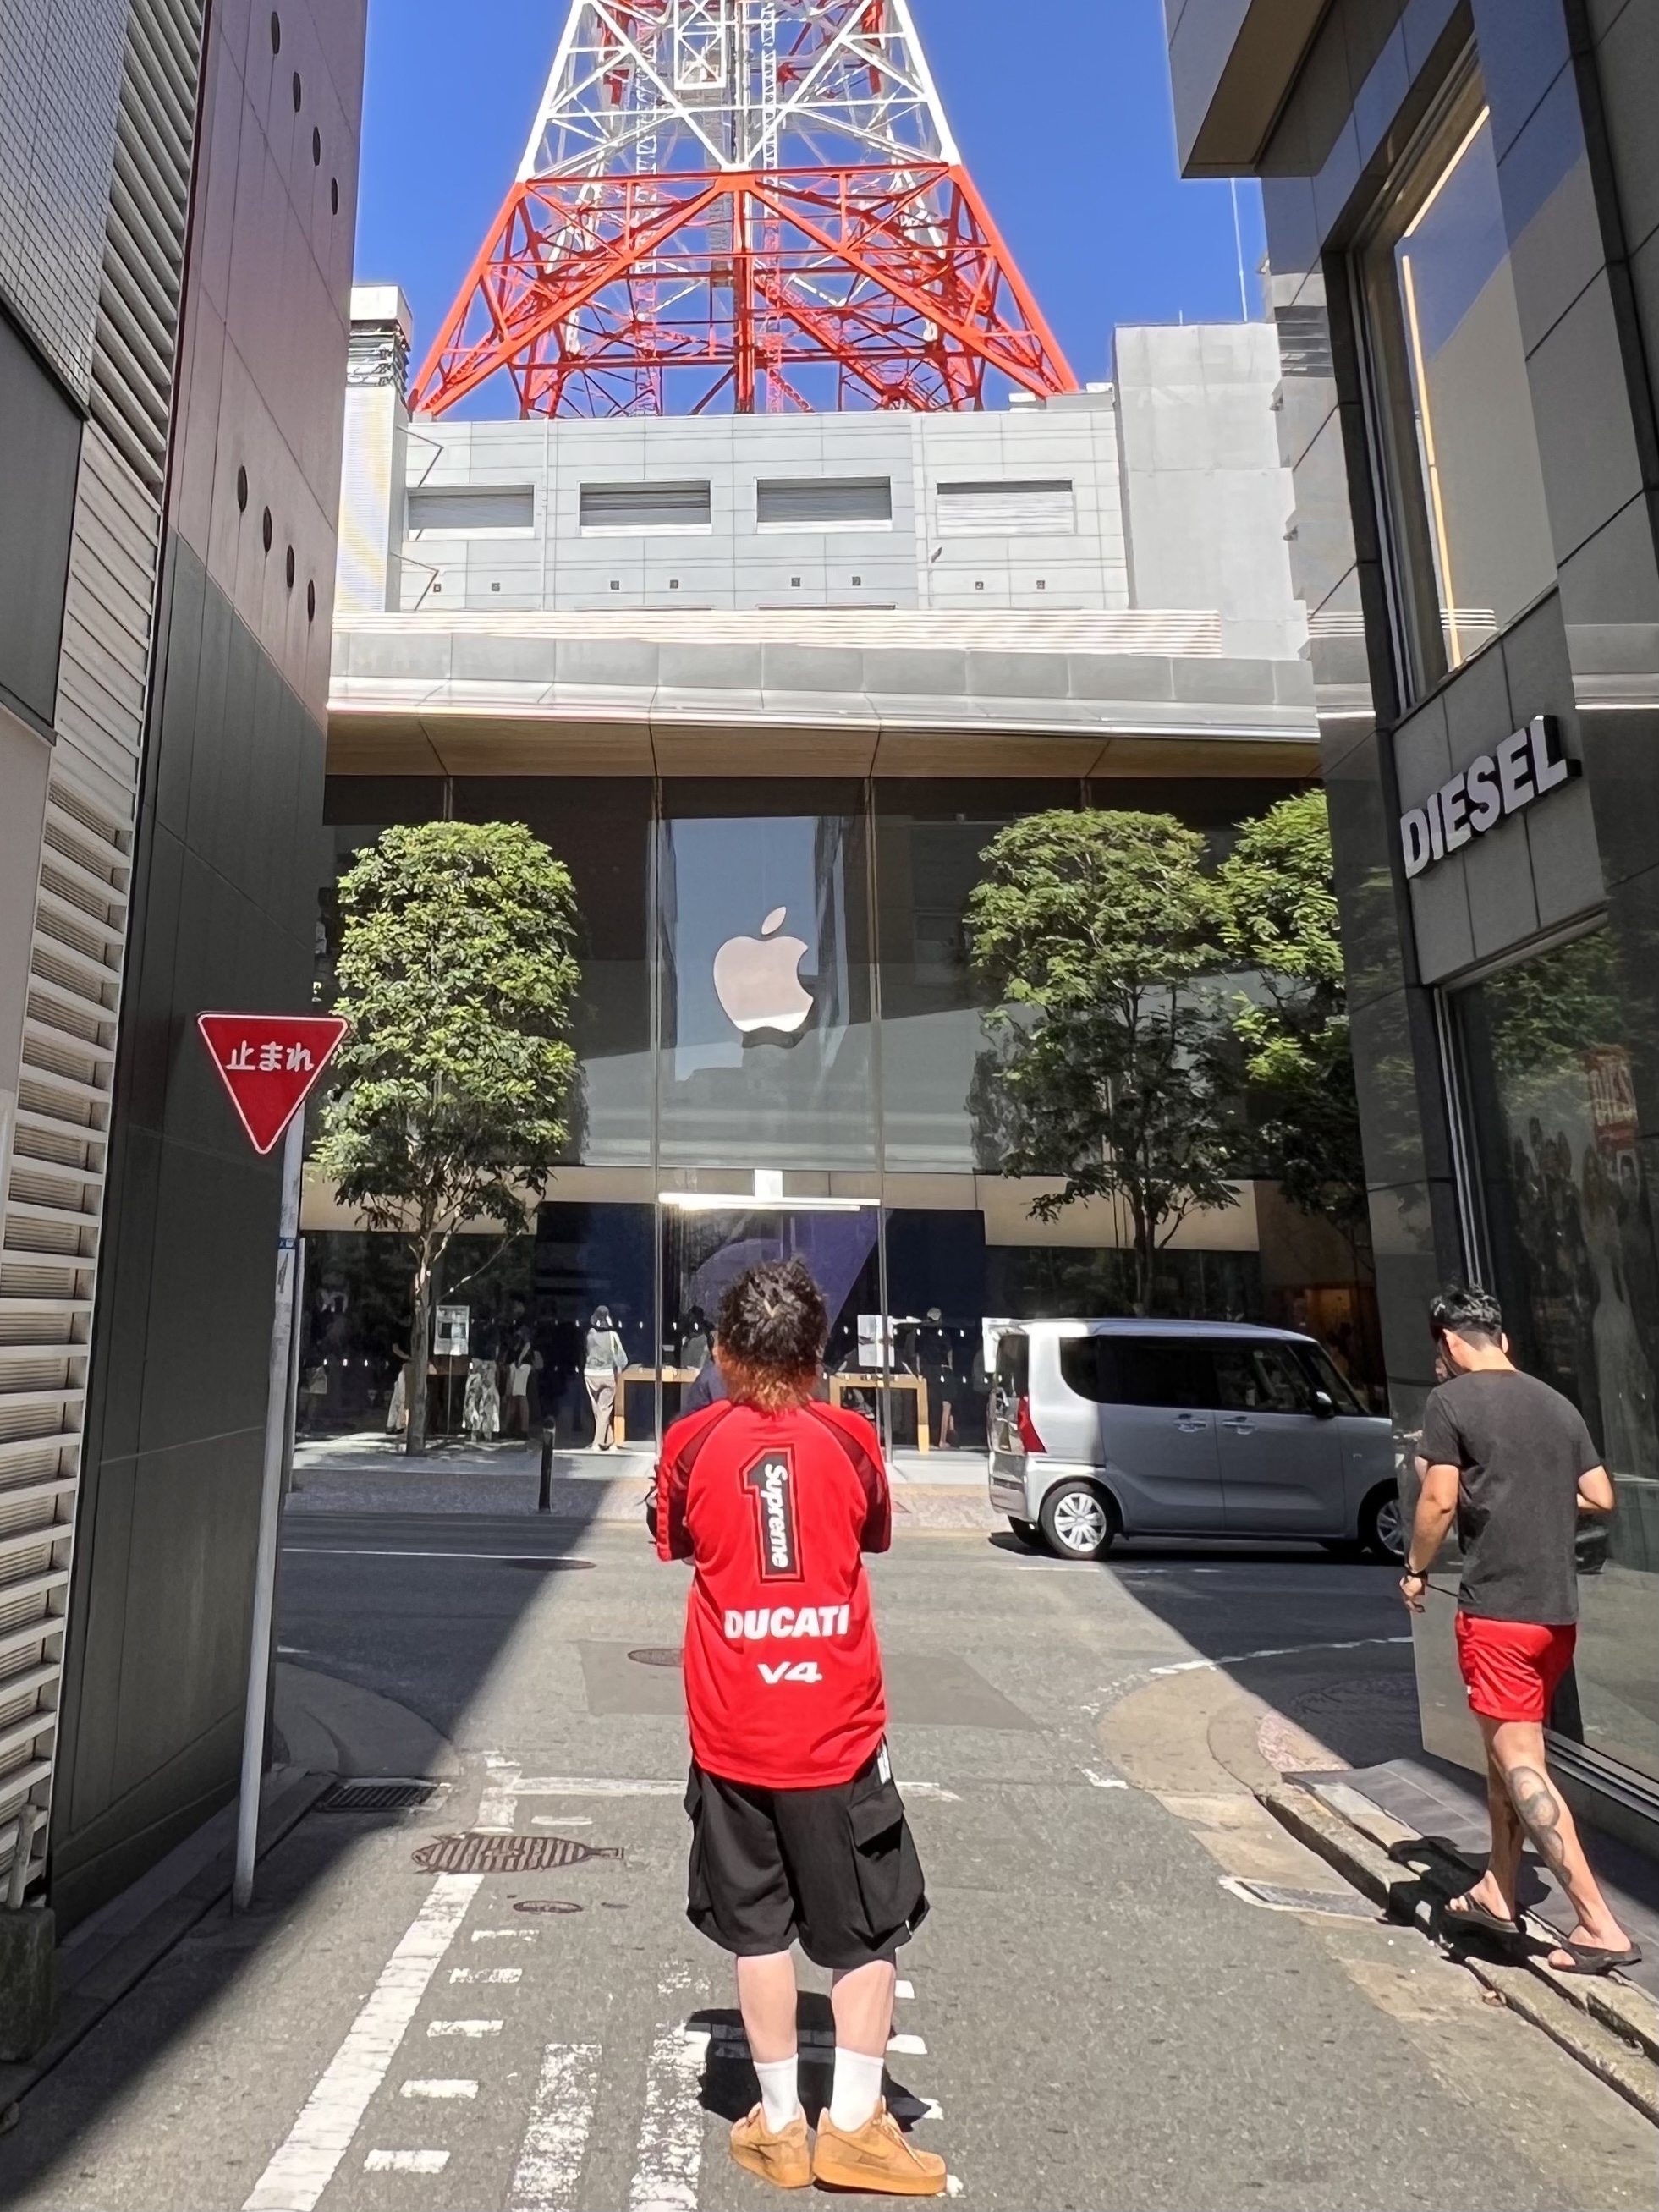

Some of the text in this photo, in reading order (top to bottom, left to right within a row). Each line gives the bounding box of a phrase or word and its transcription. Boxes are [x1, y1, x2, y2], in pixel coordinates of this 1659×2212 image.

[1400, 715, 1568, 879] DIESEL
[227, 1040, 314, 1072] 止まれ
[761, 1463, 789, 1568] Supreme
[724, 1605, 850, 1639] DUCATI
[757, 1661, 823, 1684] V4
